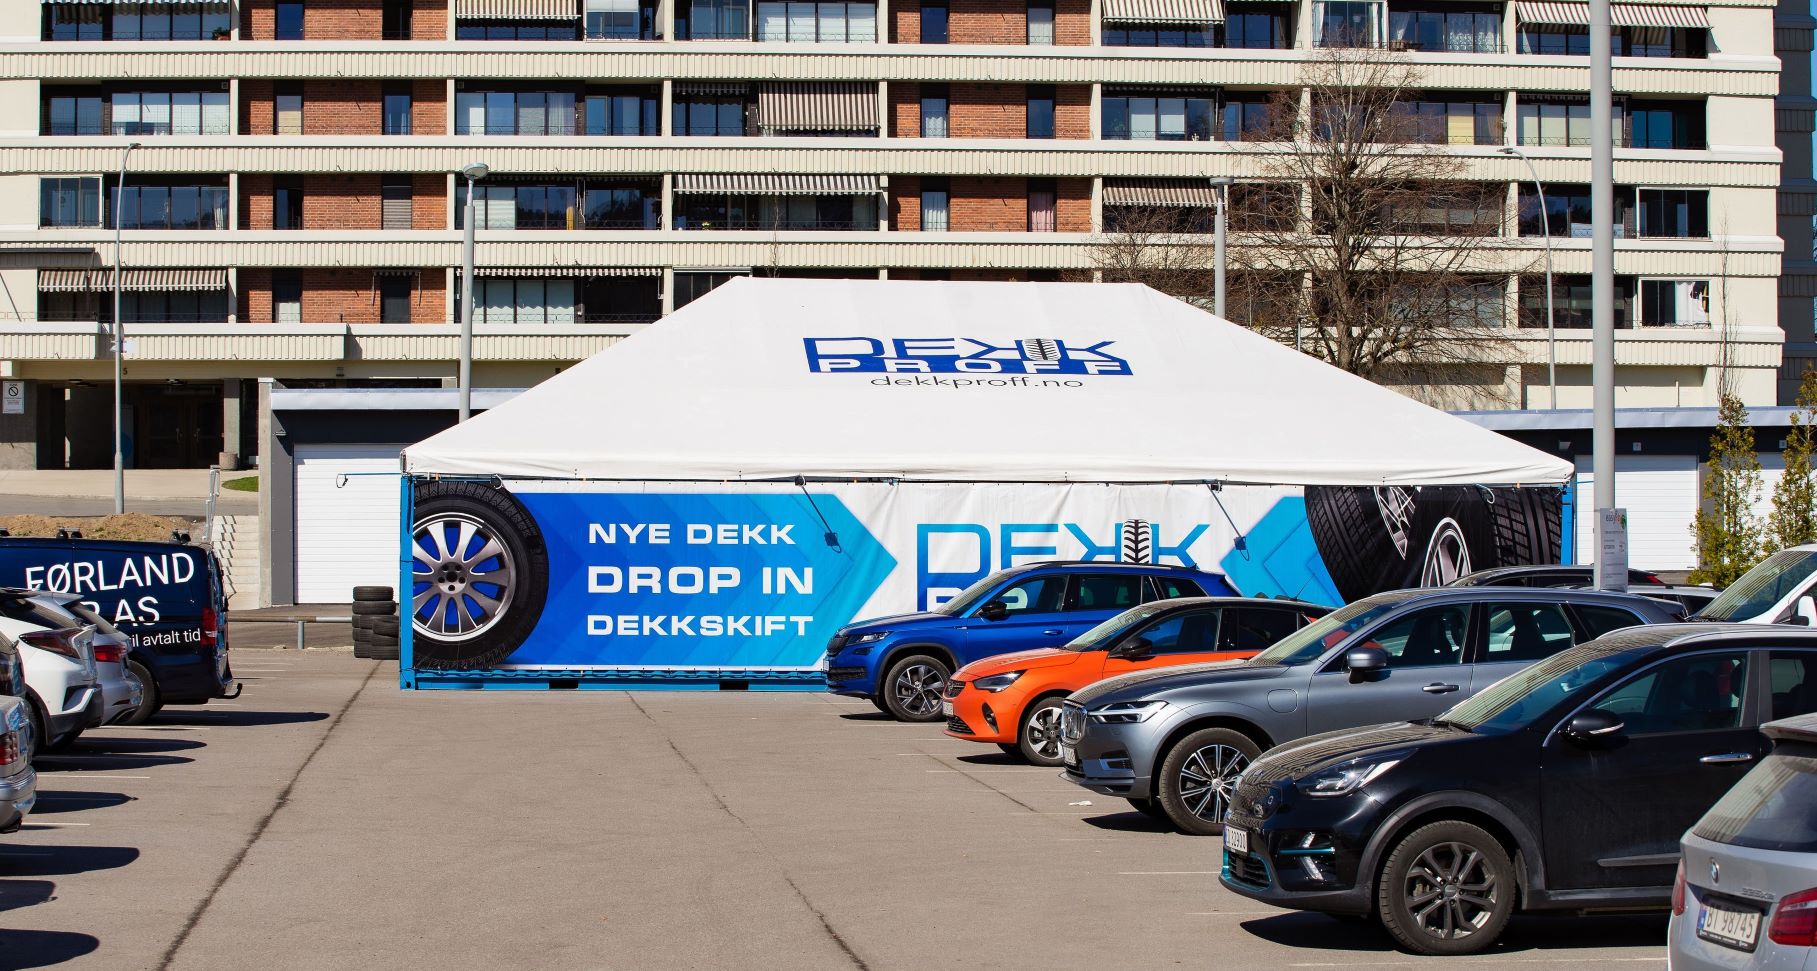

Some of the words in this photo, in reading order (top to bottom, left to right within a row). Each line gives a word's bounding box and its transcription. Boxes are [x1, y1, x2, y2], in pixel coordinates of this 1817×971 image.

[817, 358, 1124, 375] PROFF
[870, 375, 1084, 389] dekkproff.no
[588, 523, 671, 544] NYE
[686, 524, 797, 545] DEKK
[25, 552, 195, 594] FØRLAND
[587, 565, 741, 594] DROP
[762, 566, 814, 595] IN
[113, 596, 160, 627] AS
[587, 614, 814, 636] DEKKSKIFT
[142, 630, 181, 647] avtalt
[183, 628, 201, 643] tid
[1721, 908, 1755, 939] 98745
